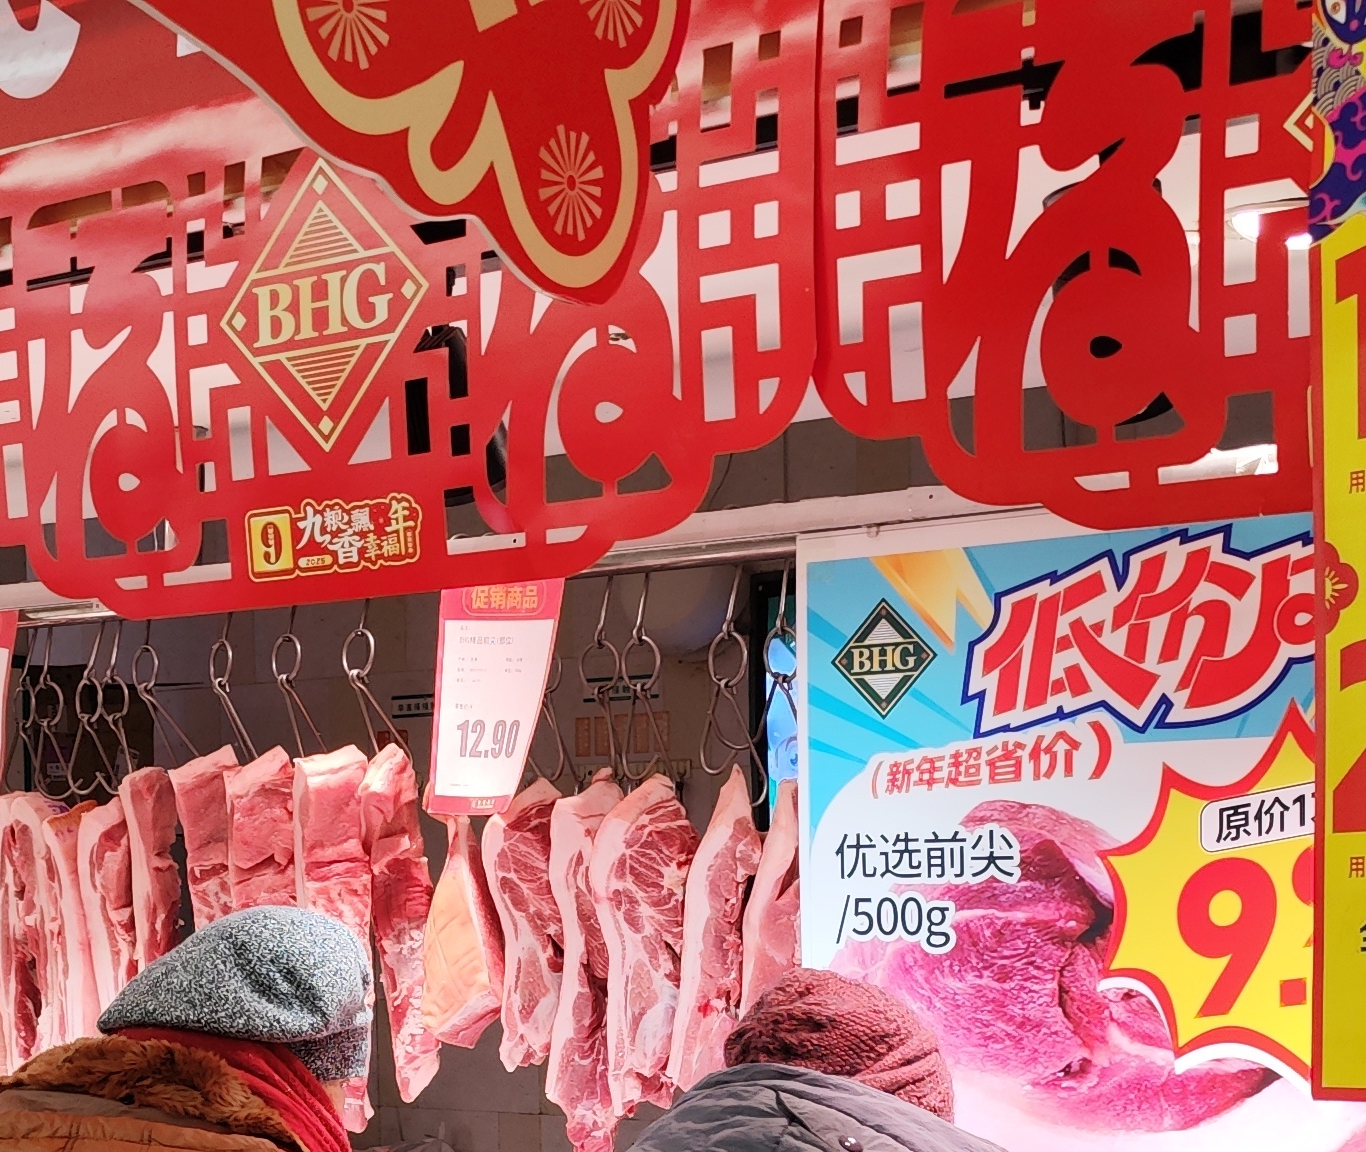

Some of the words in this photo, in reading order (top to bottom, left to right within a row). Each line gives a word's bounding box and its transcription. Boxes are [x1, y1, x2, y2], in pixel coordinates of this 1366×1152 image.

[251, 263, 392, 350] BHG
[470, 584, 539, 610] 促销商品
[847, 642, 920, 677] BHG
[456, 719, 521, 760] 12.90
[1215, 794, 1315, 845] 原价1
[834, 830, 1020, 883] 优选前尖
[835, 894, 955, 949] /500g
